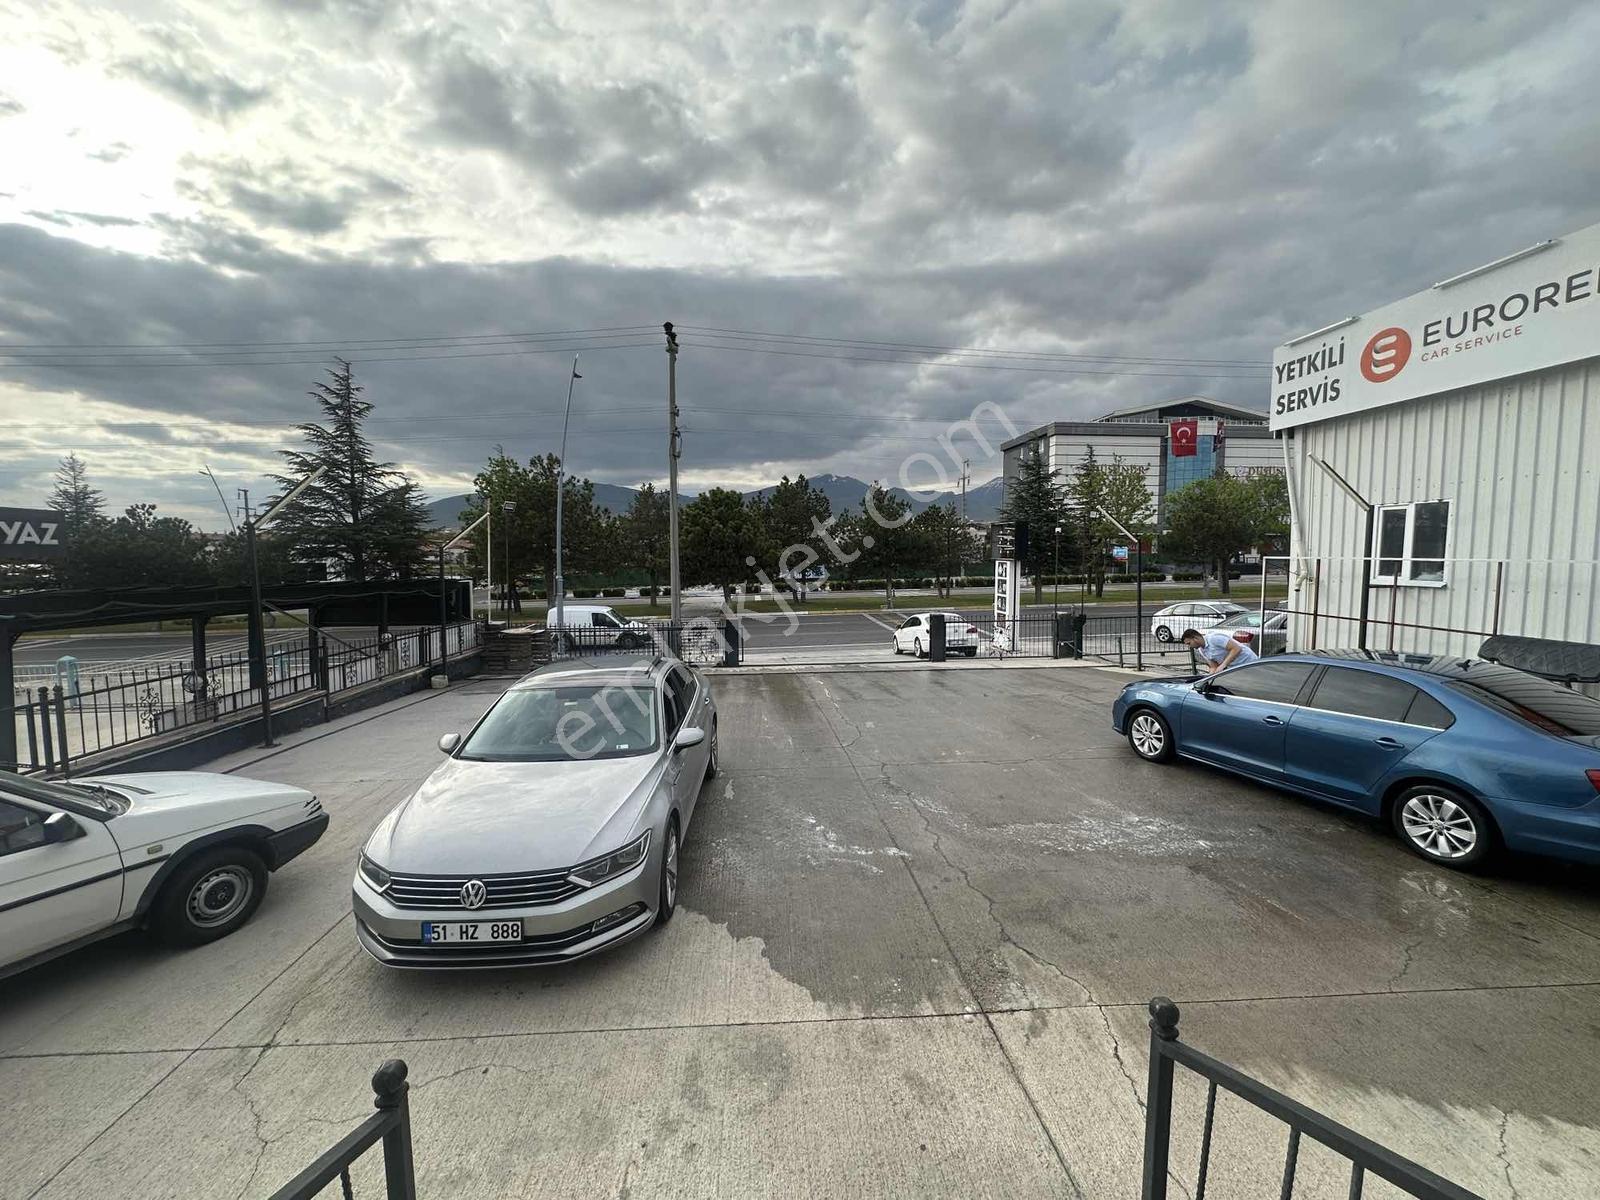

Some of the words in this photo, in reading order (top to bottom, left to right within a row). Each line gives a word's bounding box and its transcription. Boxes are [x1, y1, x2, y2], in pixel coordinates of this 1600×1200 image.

[1423, 267, 1600, 347] EURORE
[1275, 336, 1346, 384] YETKİLİ
[1421, 346, 1450, 362] CAR
[1455, 324, 1524, 352] SERVICE
[1276, 375, 1341, 416] SERVİS
[0, 521, 59, 545] YAZ
[432, 925, 447, 941] 51
[459, 925, 479, 940] HZ
[490, 923, 520, 940] 888
